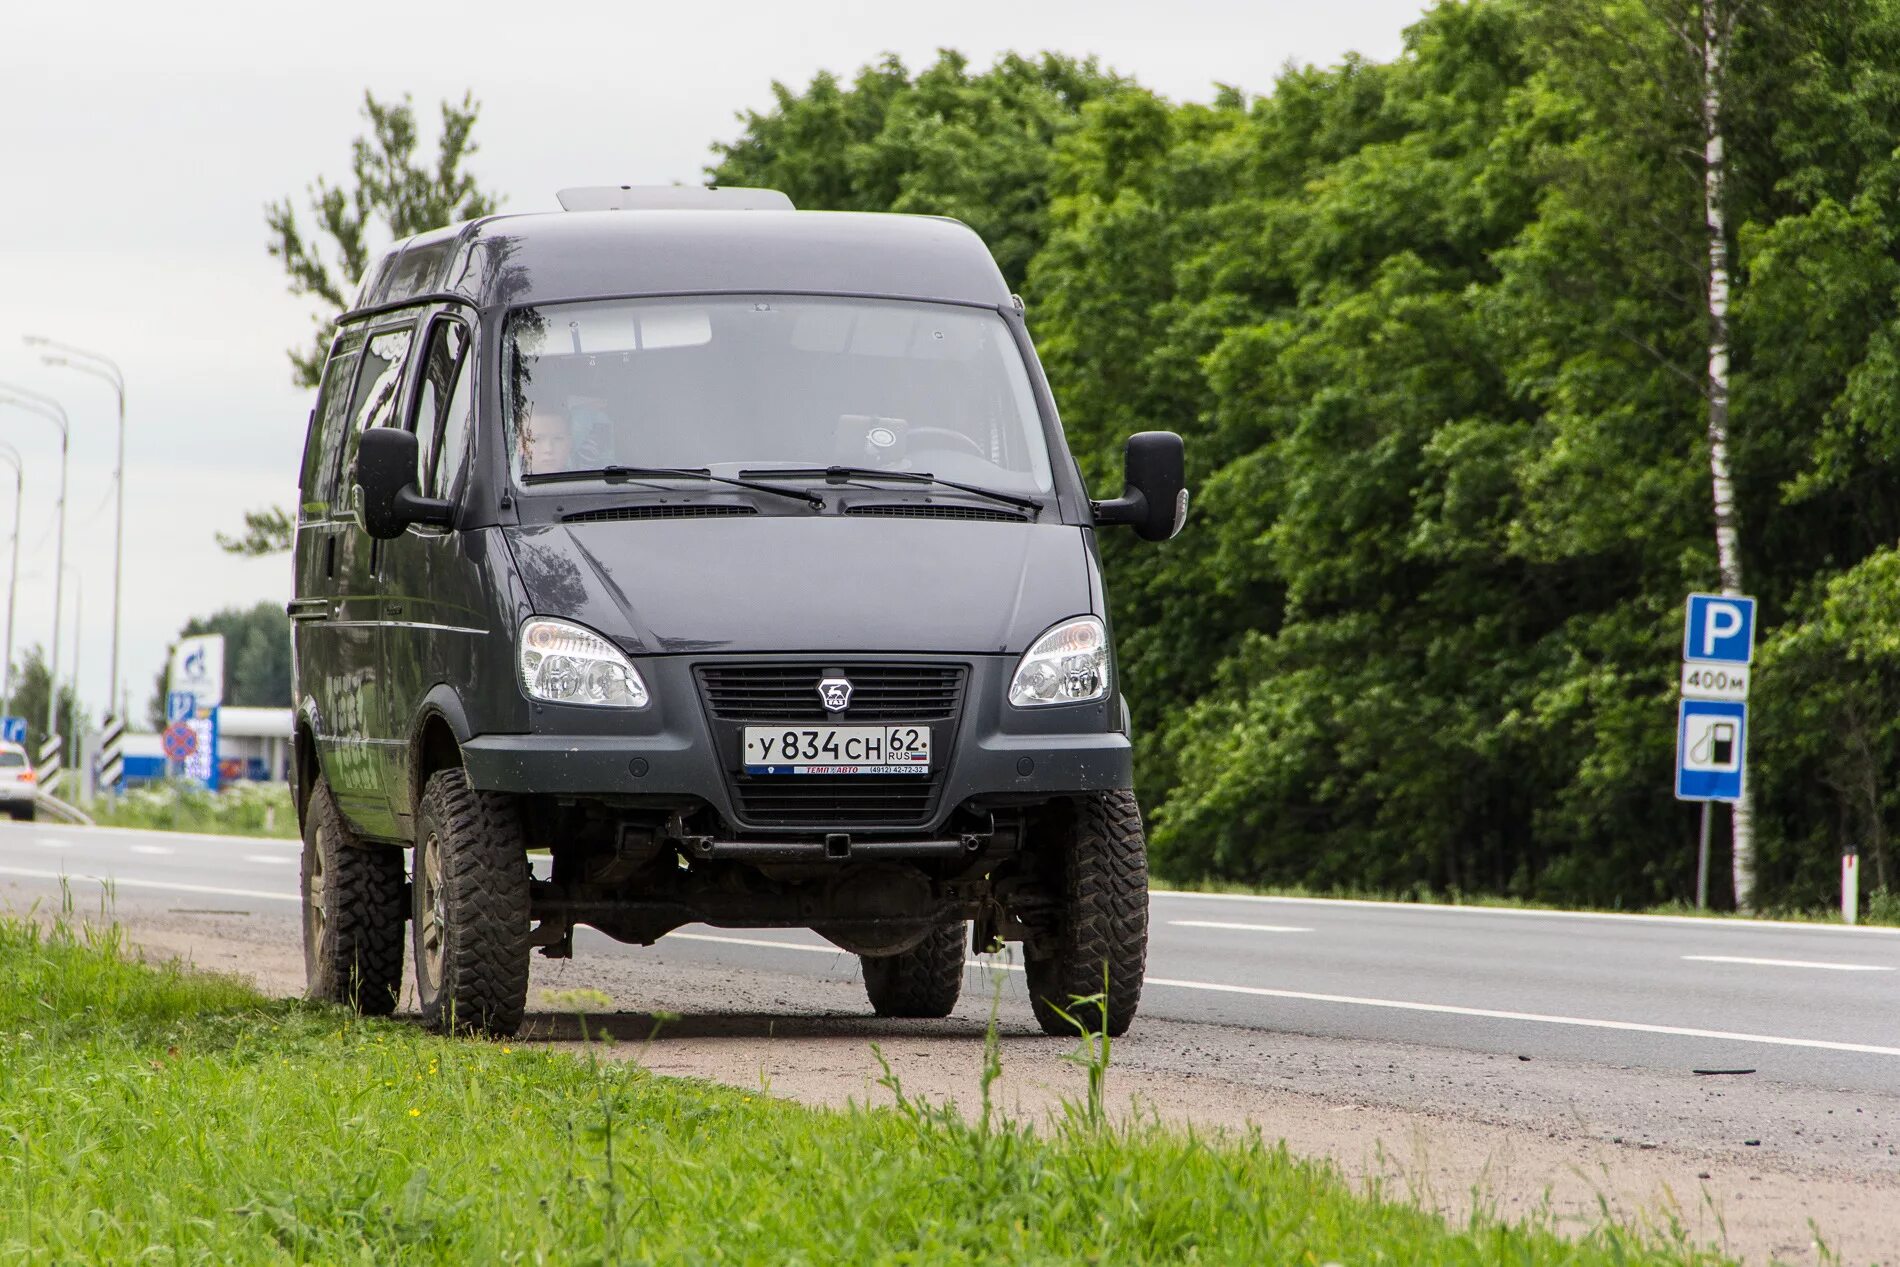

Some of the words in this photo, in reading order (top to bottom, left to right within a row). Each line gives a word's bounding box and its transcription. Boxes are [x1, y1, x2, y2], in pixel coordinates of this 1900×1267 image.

[1702, 601, 1743, 656] P
[889, 729, 919, 751] 62
[888, 751, 910, 761] RUS
[869, 766, 892, 774] (4912)
[893, 766, 923, 774] 42-72-32
